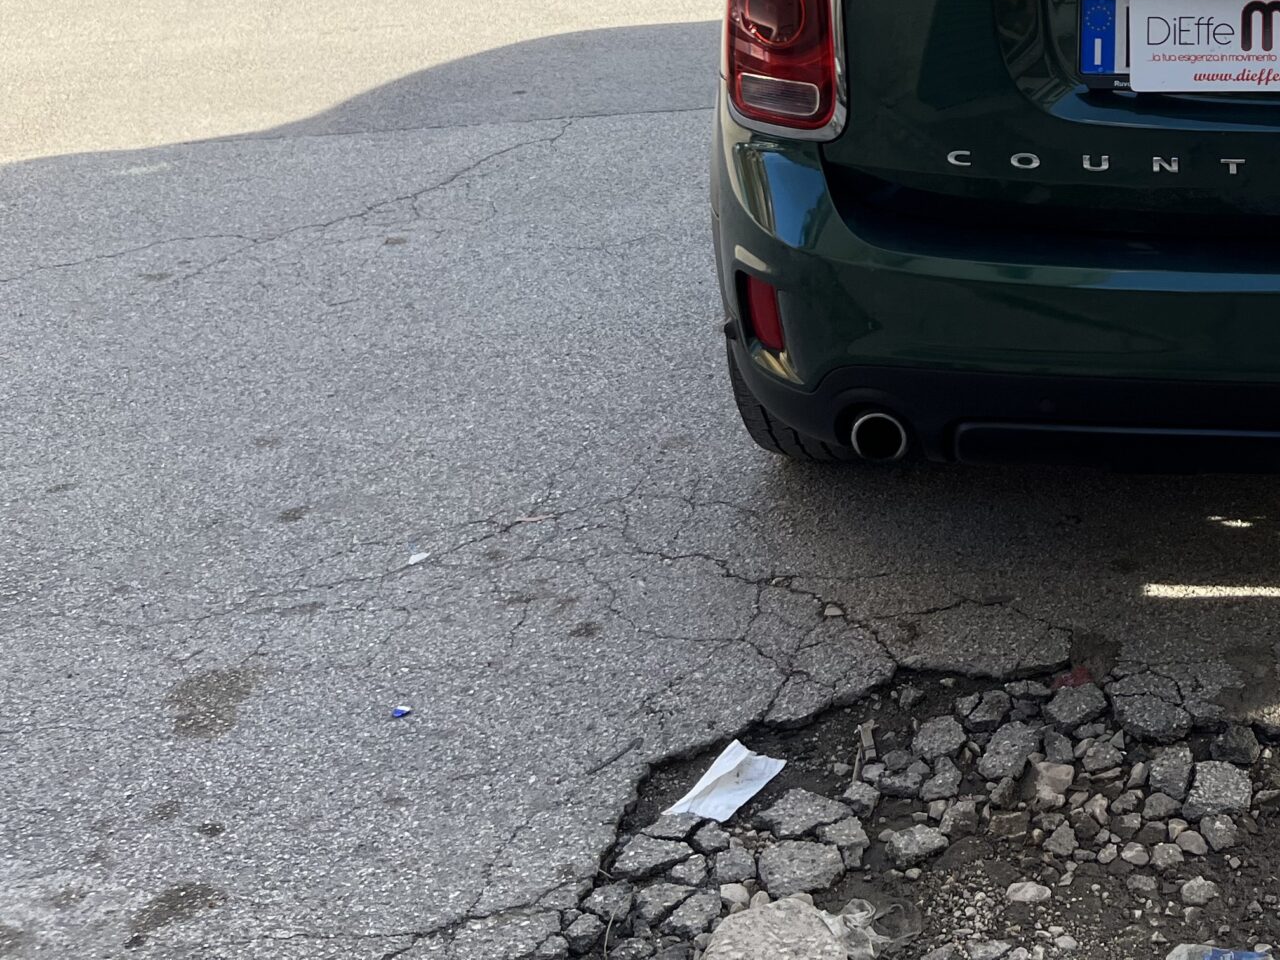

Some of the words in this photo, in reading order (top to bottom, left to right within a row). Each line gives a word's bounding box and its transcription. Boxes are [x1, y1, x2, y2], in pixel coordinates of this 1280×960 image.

[1146, 16, 1235, 46] DiEffe
[1161, 52, 1177, 62] tua
[1177, 53, 1220, 64] esigenza
[1228, 52, 1278, 62] movimento
